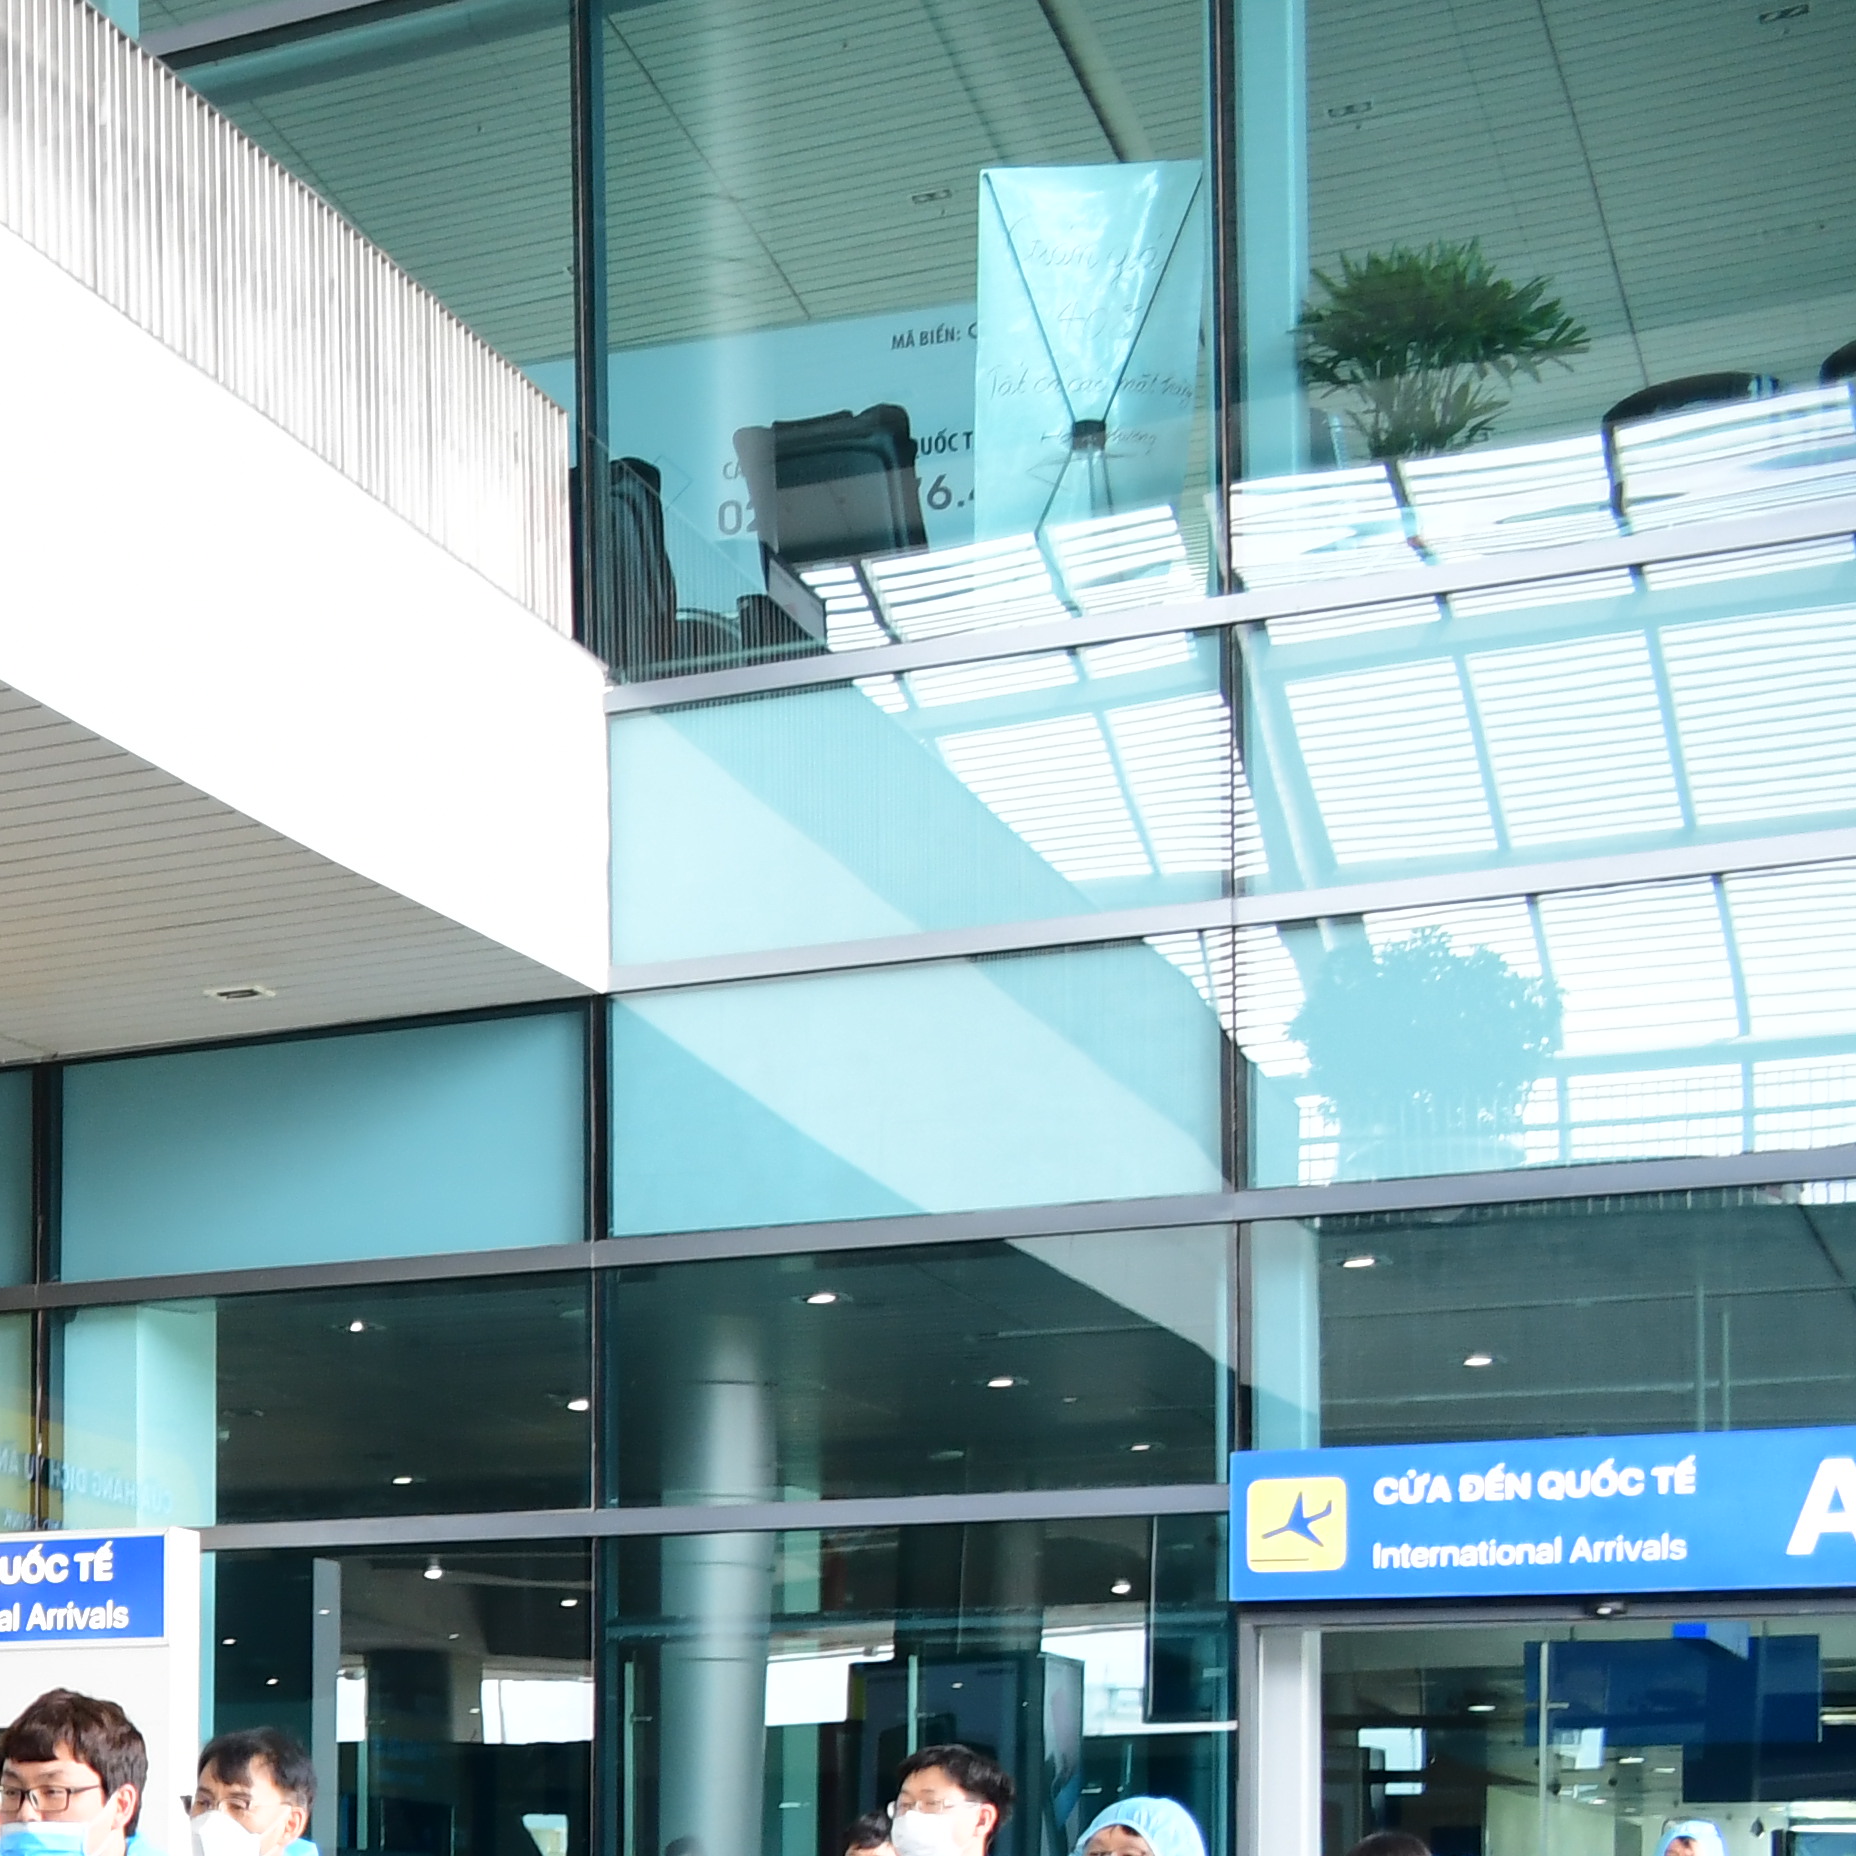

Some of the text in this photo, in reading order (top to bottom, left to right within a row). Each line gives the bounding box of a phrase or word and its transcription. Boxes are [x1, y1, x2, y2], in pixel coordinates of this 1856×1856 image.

[917, 428, 958, 457] UỐC
[1373, 1468, 1453, 1506] CỬA
[1458, 1462, 1532, 1502] ĐẾN
[1537, 1458, 1646, 1502] QUỐC
[1651, 1455, 1697, 1495] TẾ
[73, 1540, 115, 1583] TẾ
[1372, 1532, 1688, 1571] International Arrivals
[26, 1597, 129, 1632] Arrivals
